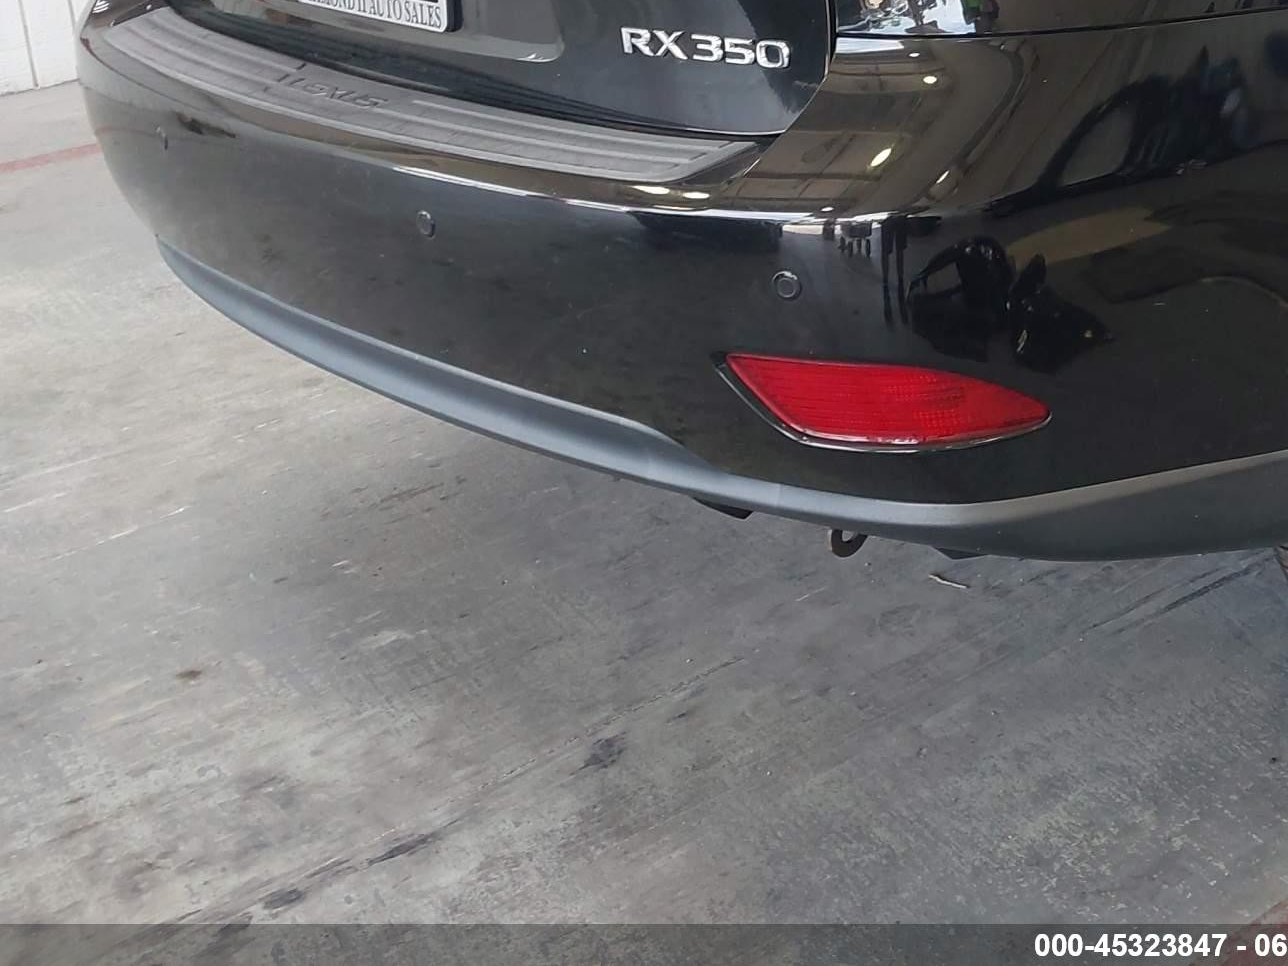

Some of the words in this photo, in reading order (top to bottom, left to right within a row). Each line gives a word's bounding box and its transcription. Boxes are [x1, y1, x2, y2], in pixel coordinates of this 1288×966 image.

[403, 0, 442, 28] SALES
[621, 27, 688, 60] RX
[691, 34, 791, 69] 350
